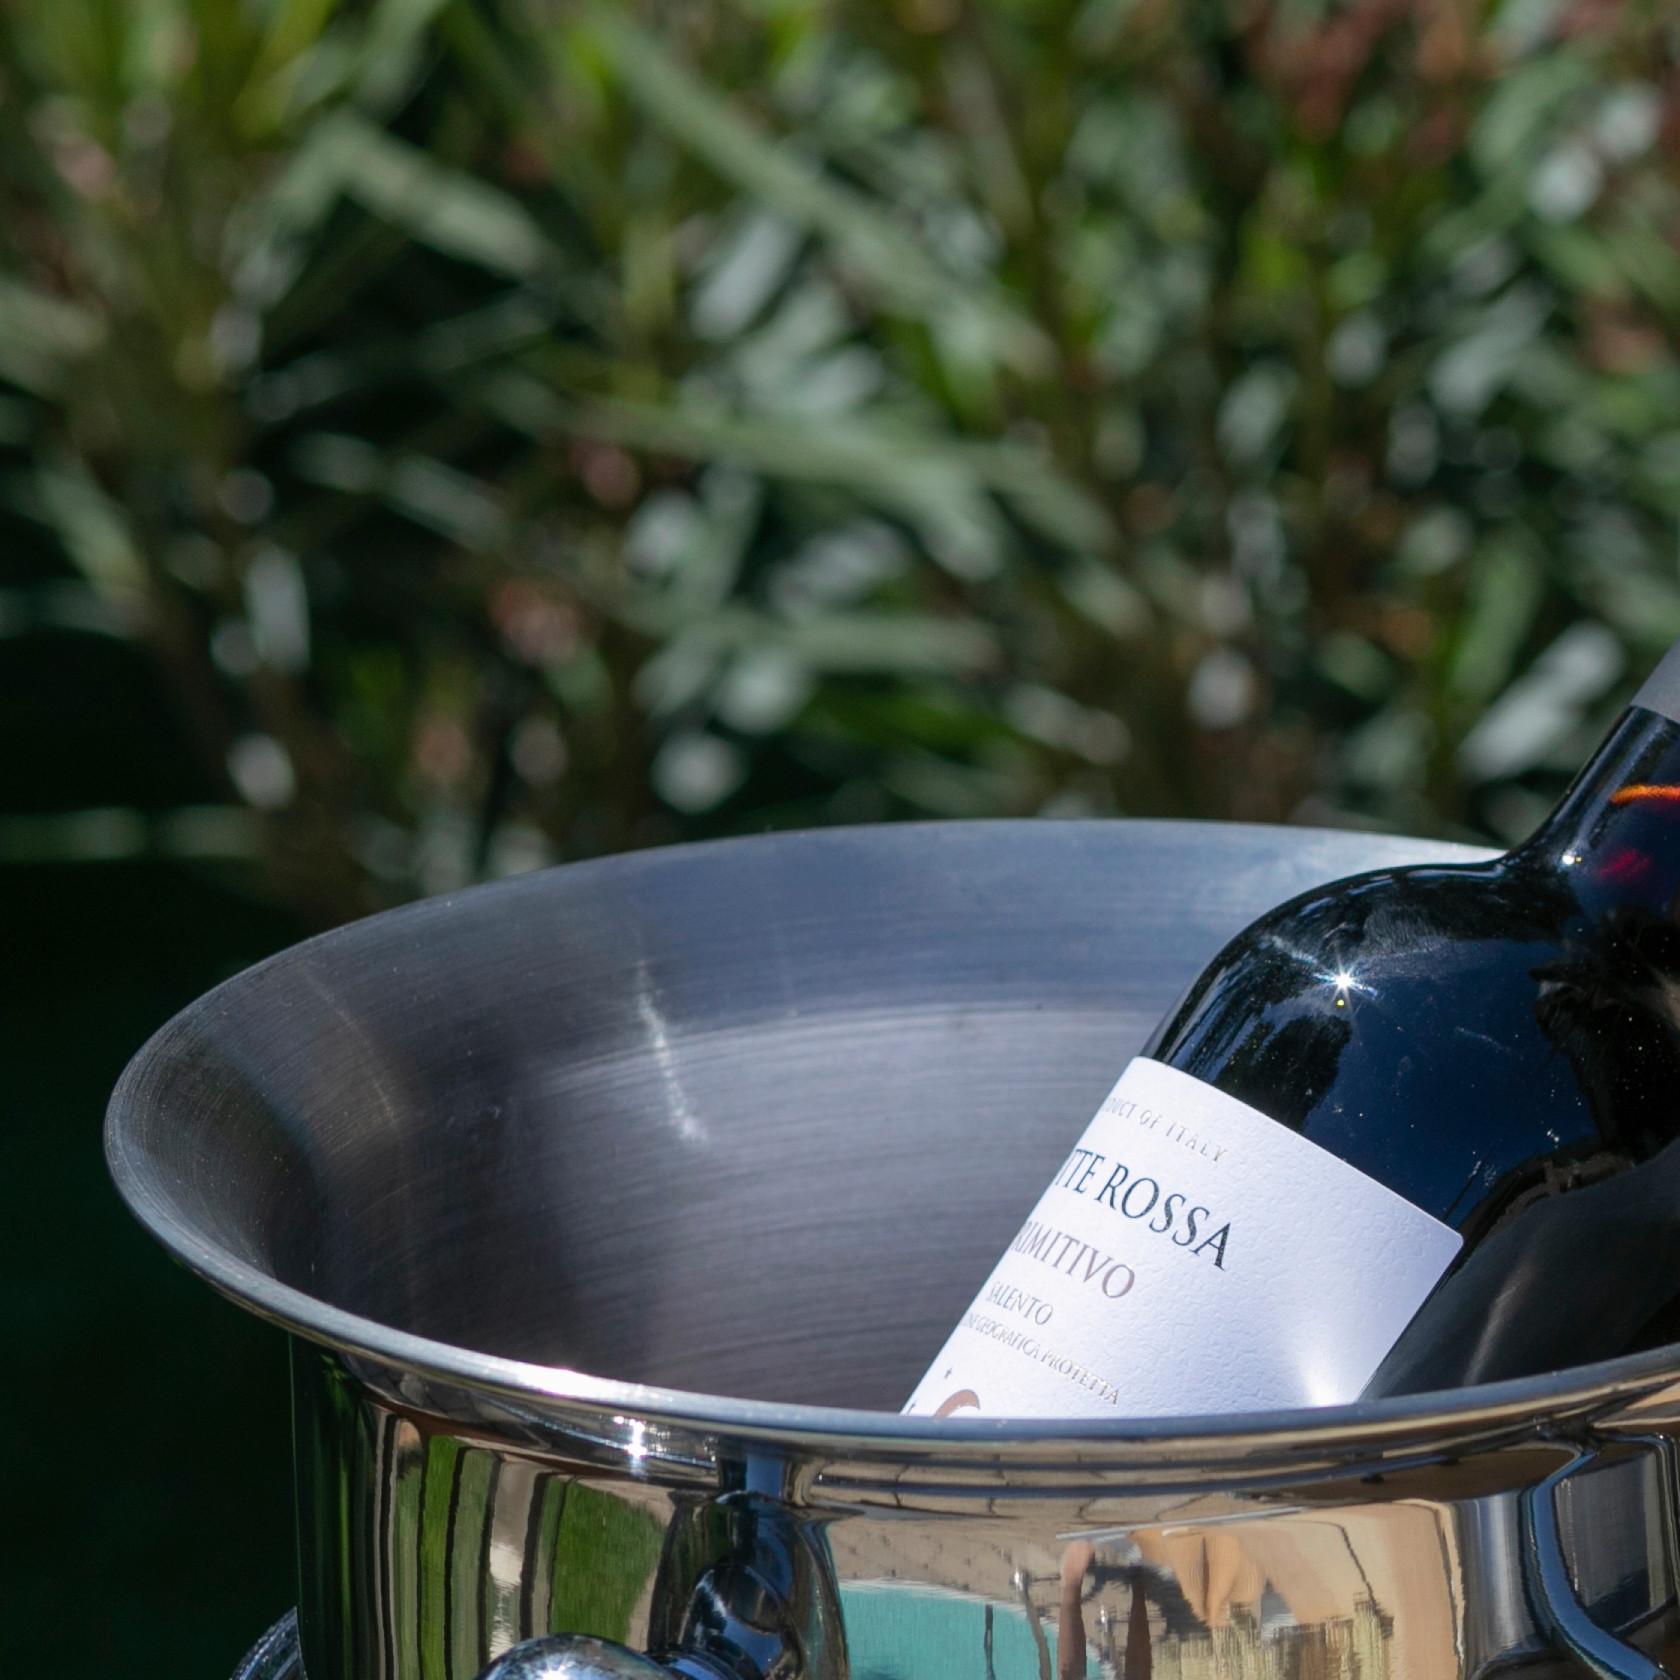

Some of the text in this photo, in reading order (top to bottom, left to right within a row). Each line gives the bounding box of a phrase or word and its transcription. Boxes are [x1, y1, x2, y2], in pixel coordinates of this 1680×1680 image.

[1140, 1109, 1162, 1129] OF
[1165, 1122, 1229, 1162] ITALY
[1094, 1163, 1231, 1271] ROSSA
[1041, 1348, 1119, 1405] PROTETTA
